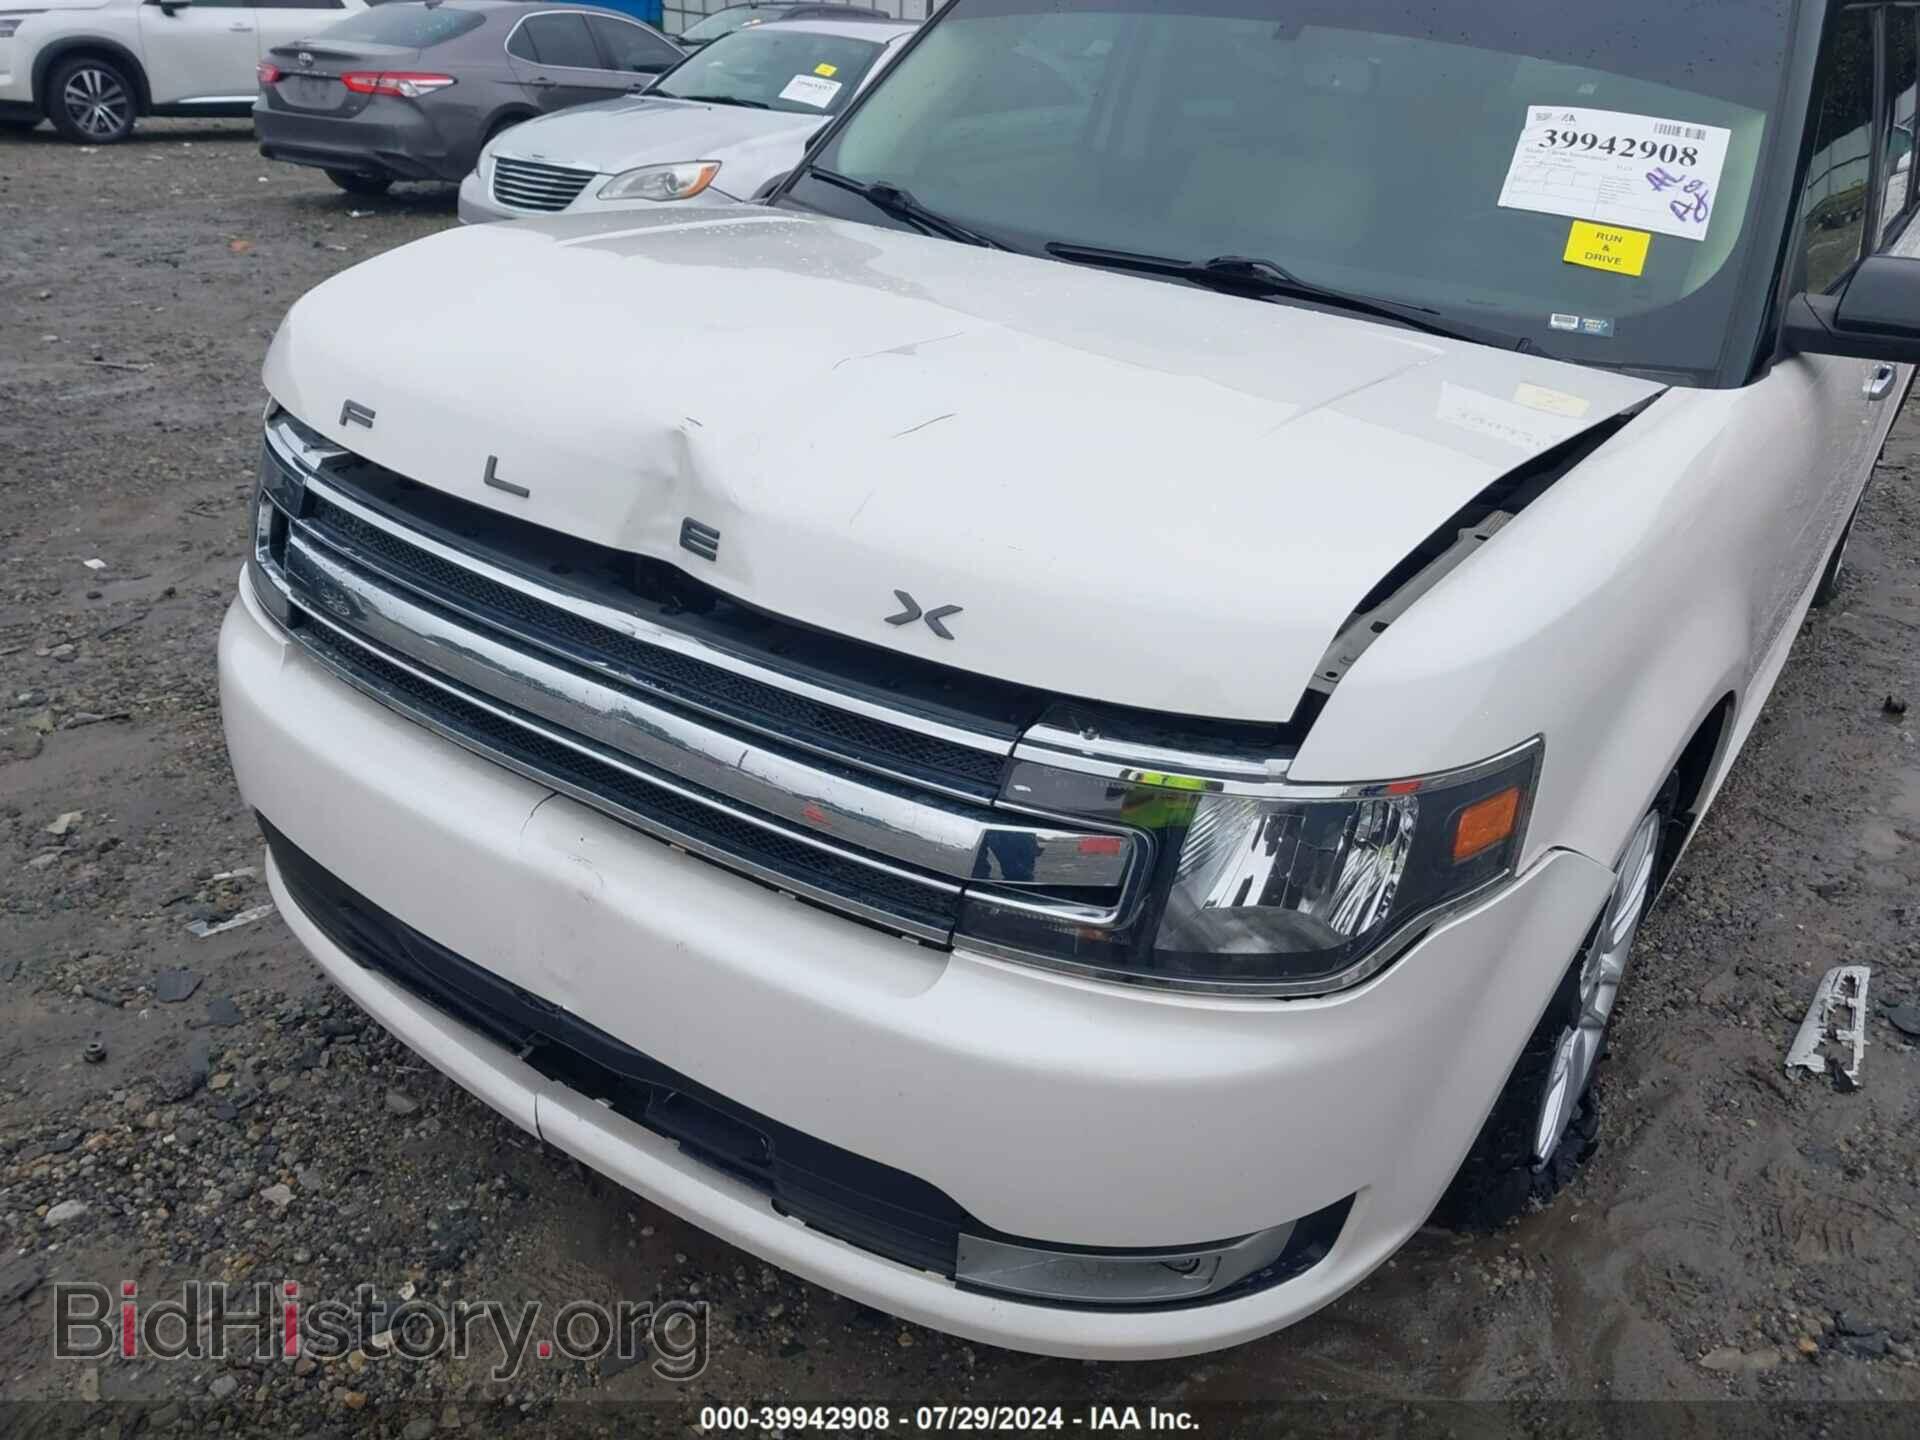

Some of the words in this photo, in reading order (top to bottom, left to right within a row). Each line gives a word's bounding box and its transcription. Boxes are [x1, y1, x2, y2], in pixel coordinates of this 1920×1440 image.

[1538, 128, 1699, 167] 39942908
[1596, 232, 1623, 244] RUN
[1584, 251, 1623, 266] DRIVE
[339, 399, 963, 640] FLEX
